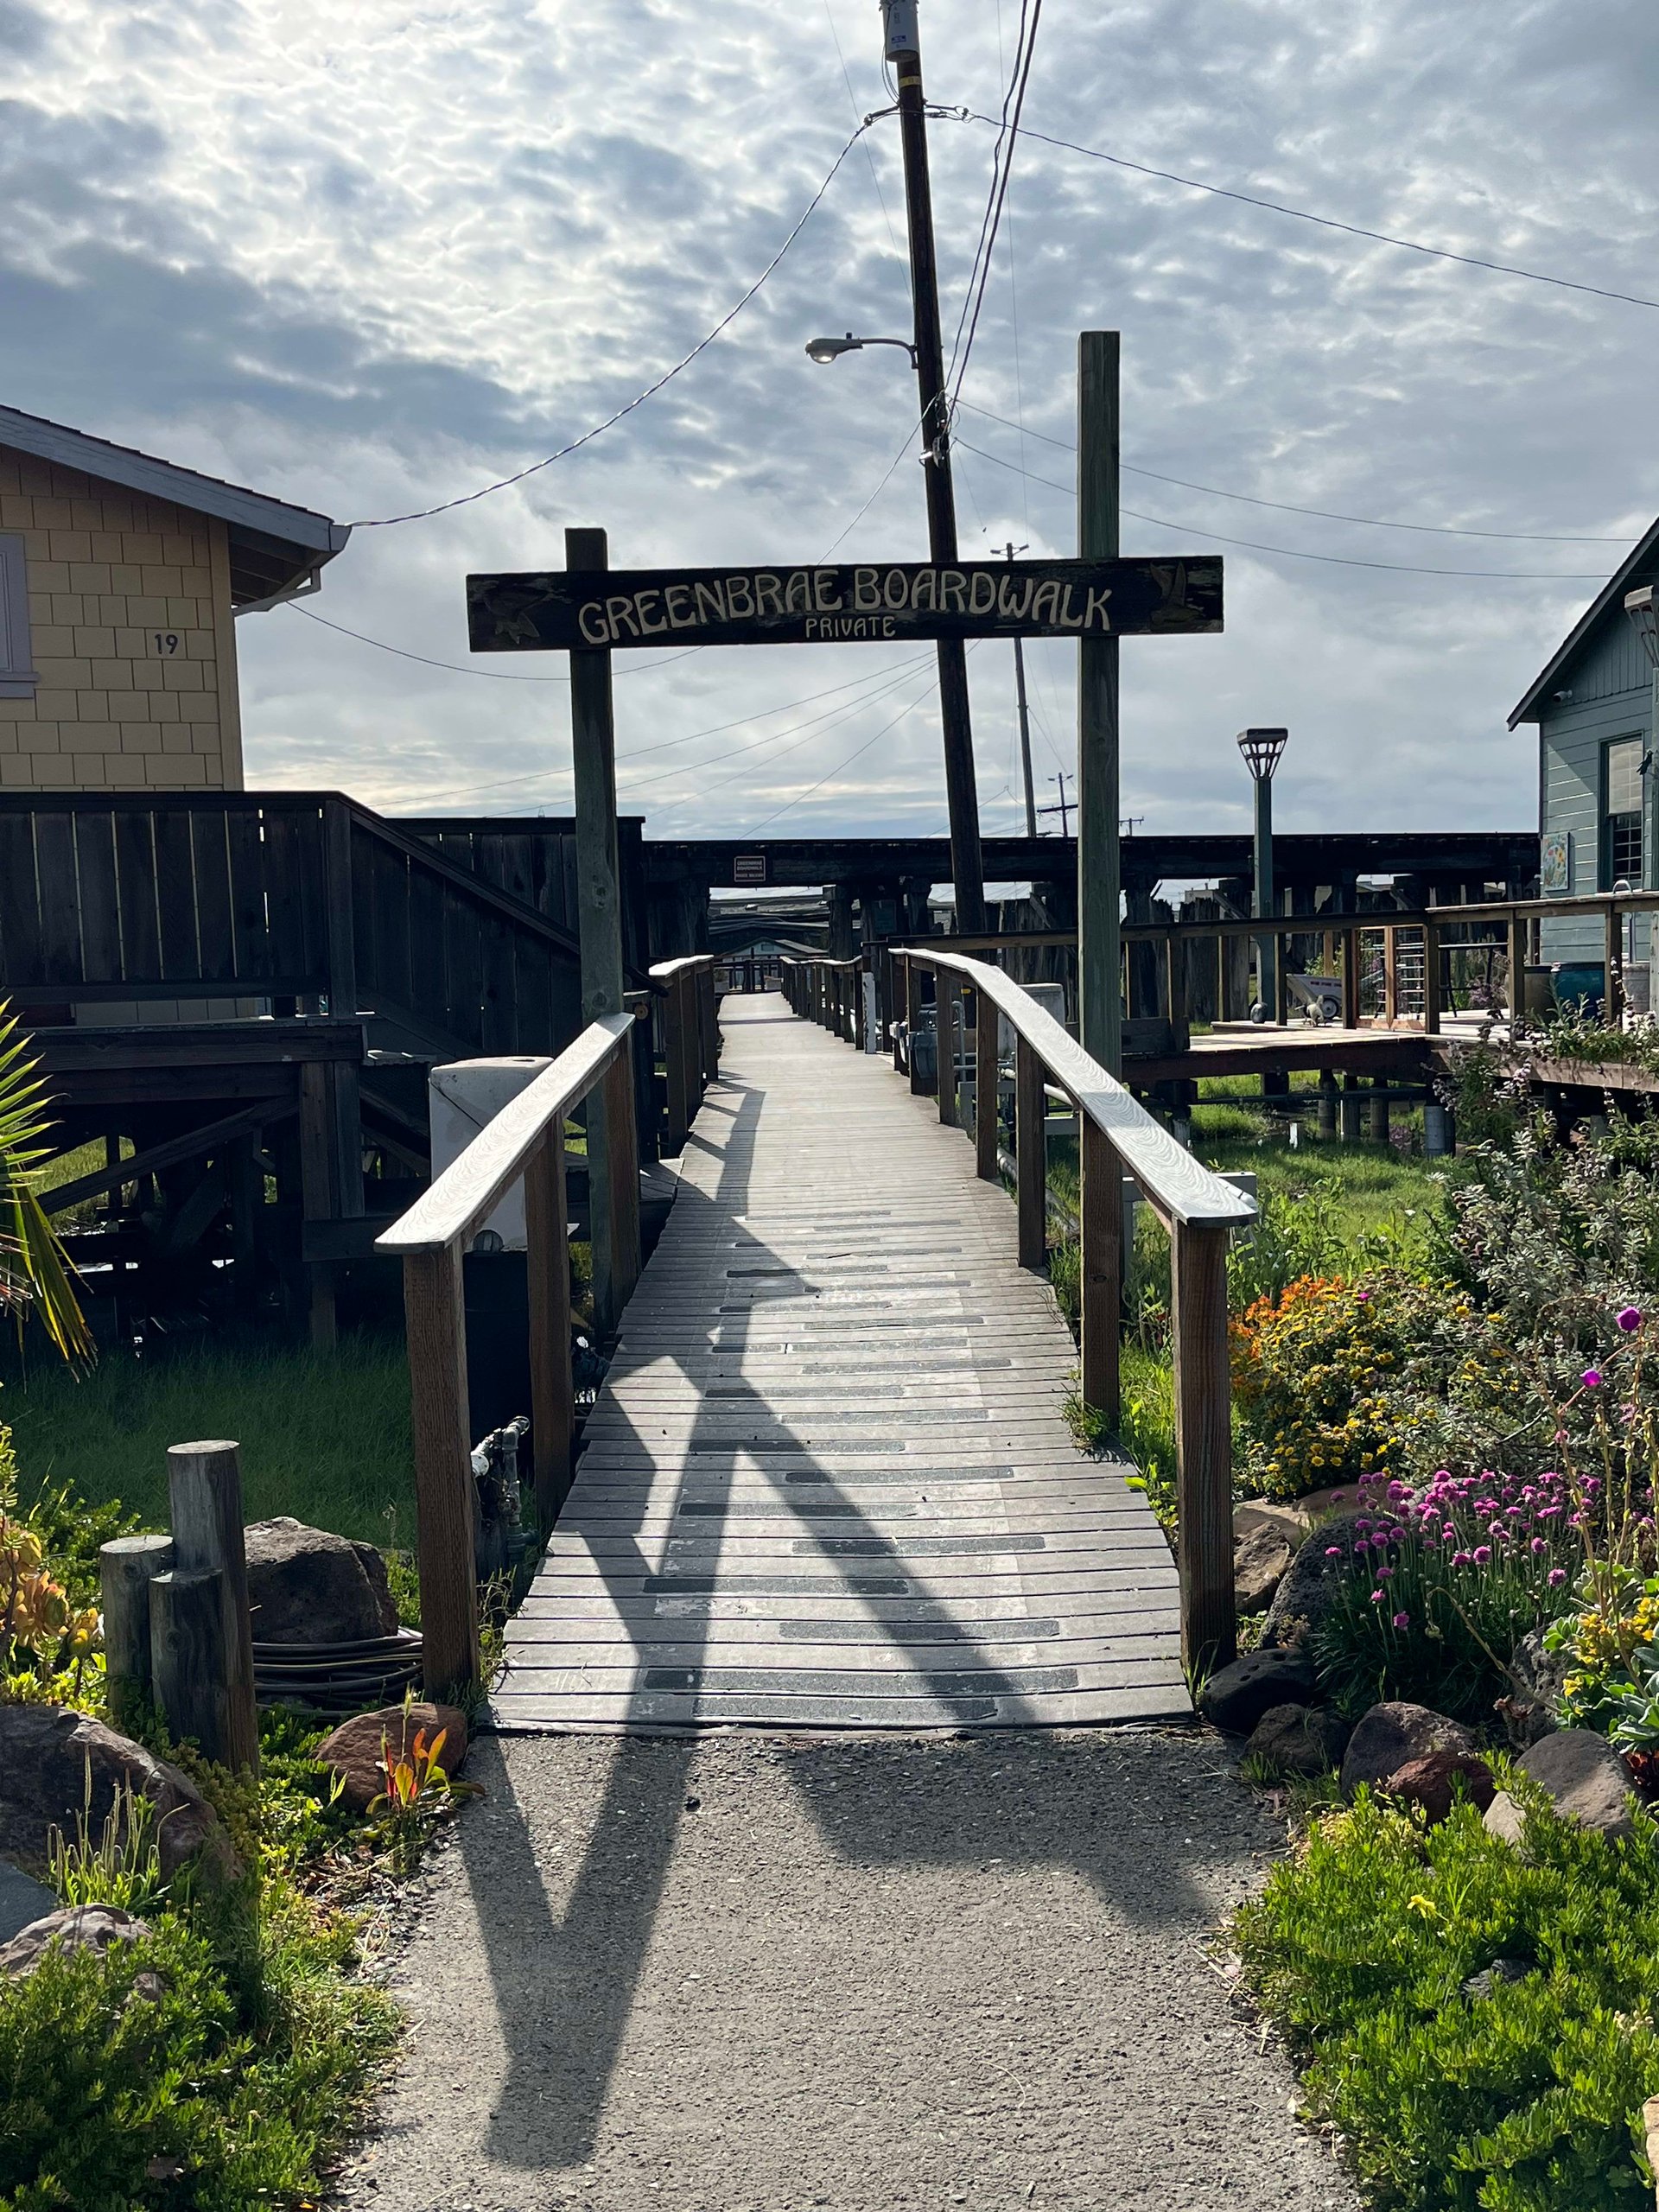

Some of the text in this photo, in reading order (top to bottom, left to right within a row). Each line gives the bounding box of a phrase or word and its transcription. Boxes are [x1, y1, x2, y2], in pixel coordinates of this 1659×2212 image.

[578, 569, 1112, 645] GREENBRAE BOARDWALK
[805, 616, 896, 639] PRIVATE
[155, 633, 178, 654] 19
